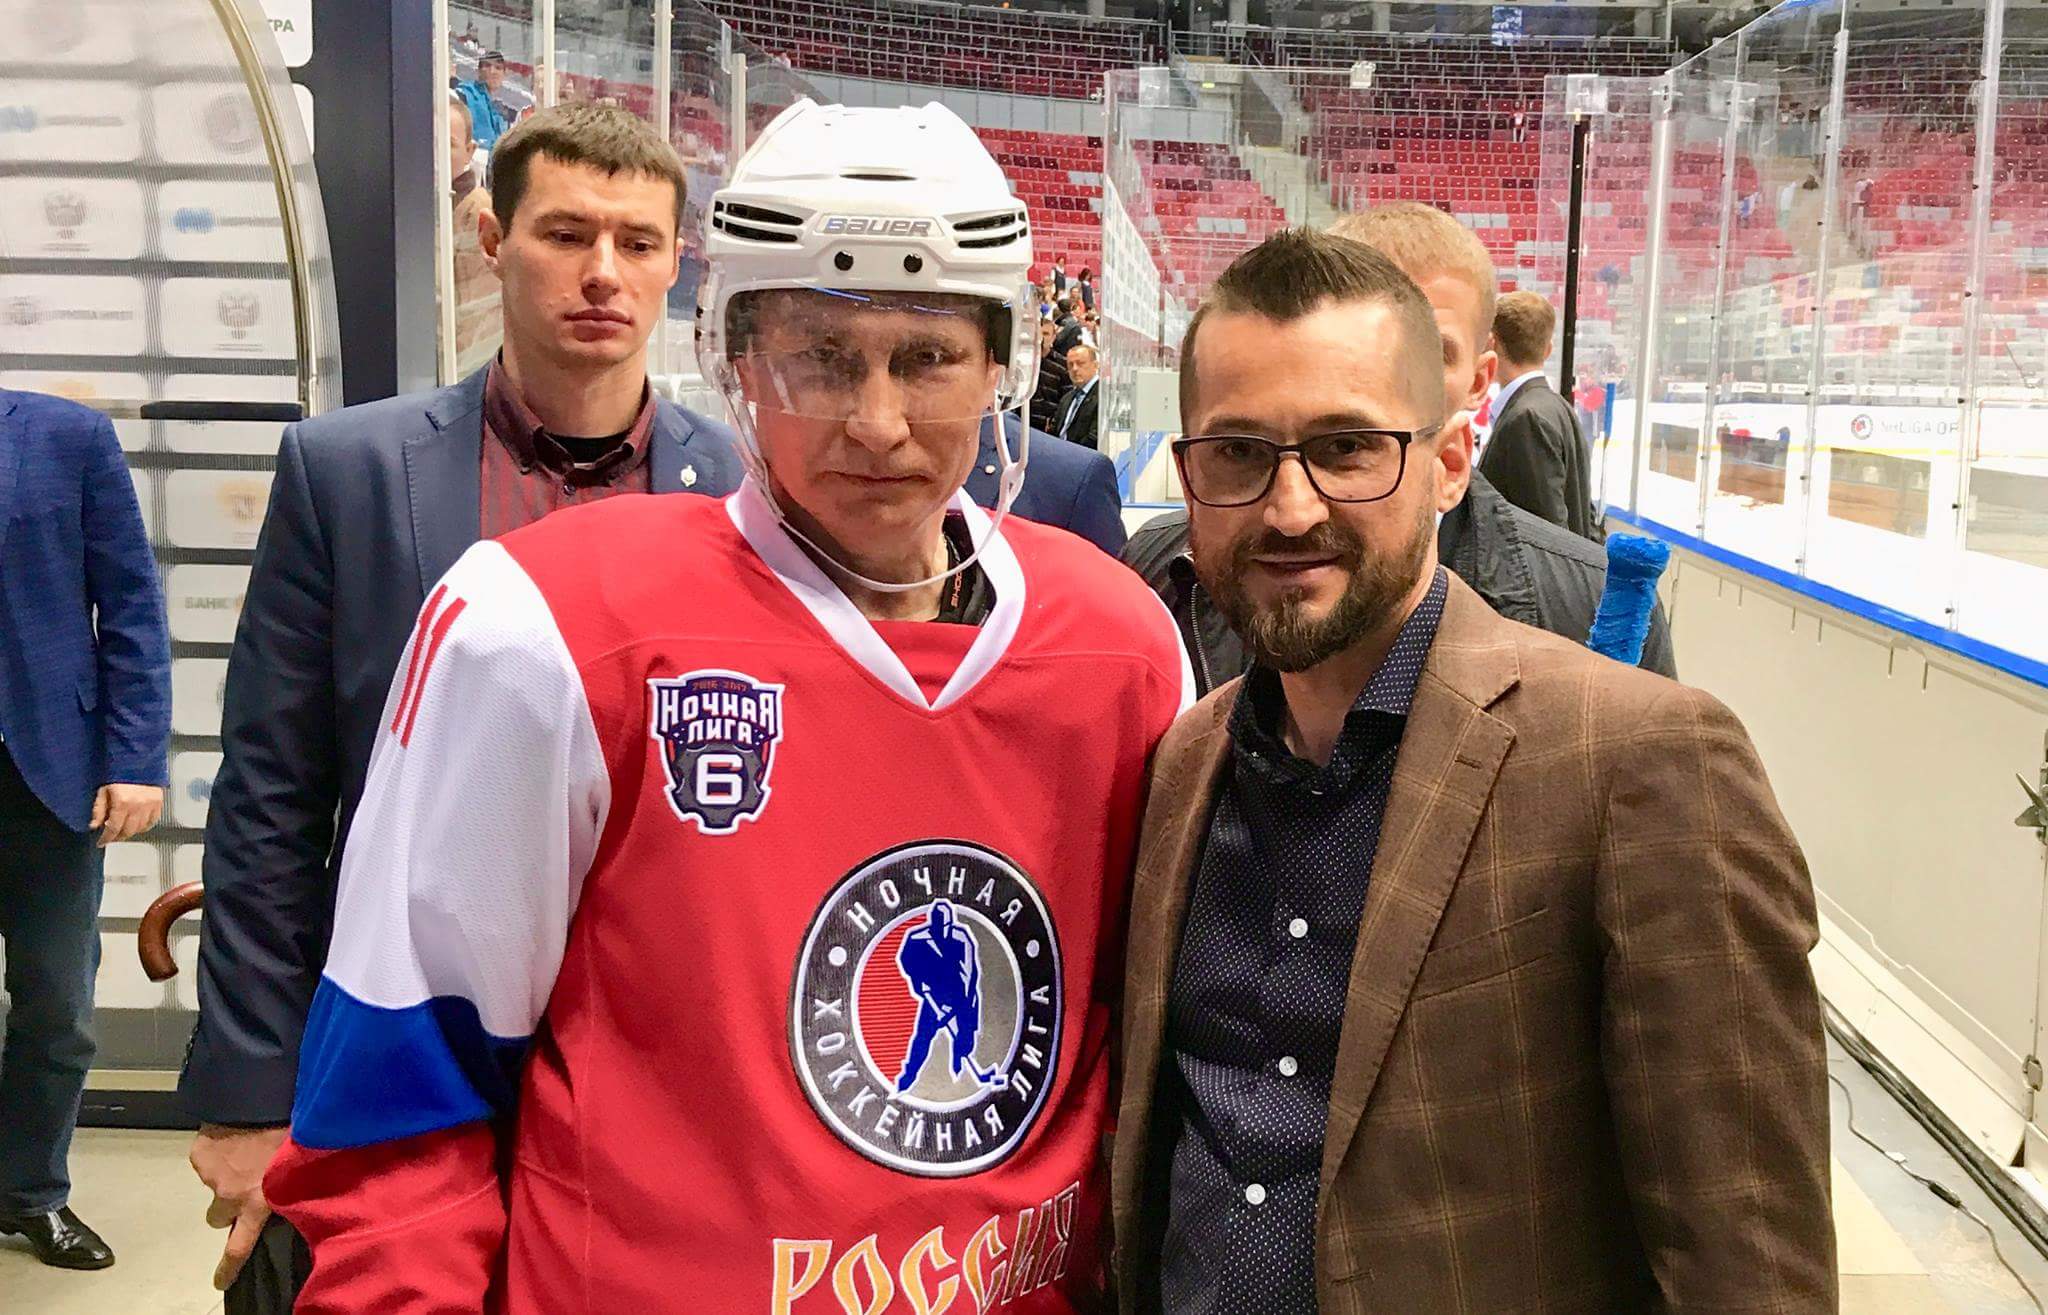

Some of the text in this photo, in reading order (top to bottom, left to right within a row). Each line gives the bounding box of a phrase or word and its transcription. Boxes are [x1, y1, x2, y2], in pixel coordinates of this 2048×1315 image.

[824, 218, 931, 237] BAUER
[660, 689, 776, 736] НОЧНАЯ
[687, 718, 753, 745] ЛИГА
[696, 753, 743, 805] 6
[846, 867, 1023, 933] НОЧНАЯ
[814, 984, 1050, 1151] ХОККЕЙНАЯ ЛИГА
[771, 1180, 1081, 1315] РОССИЯ
